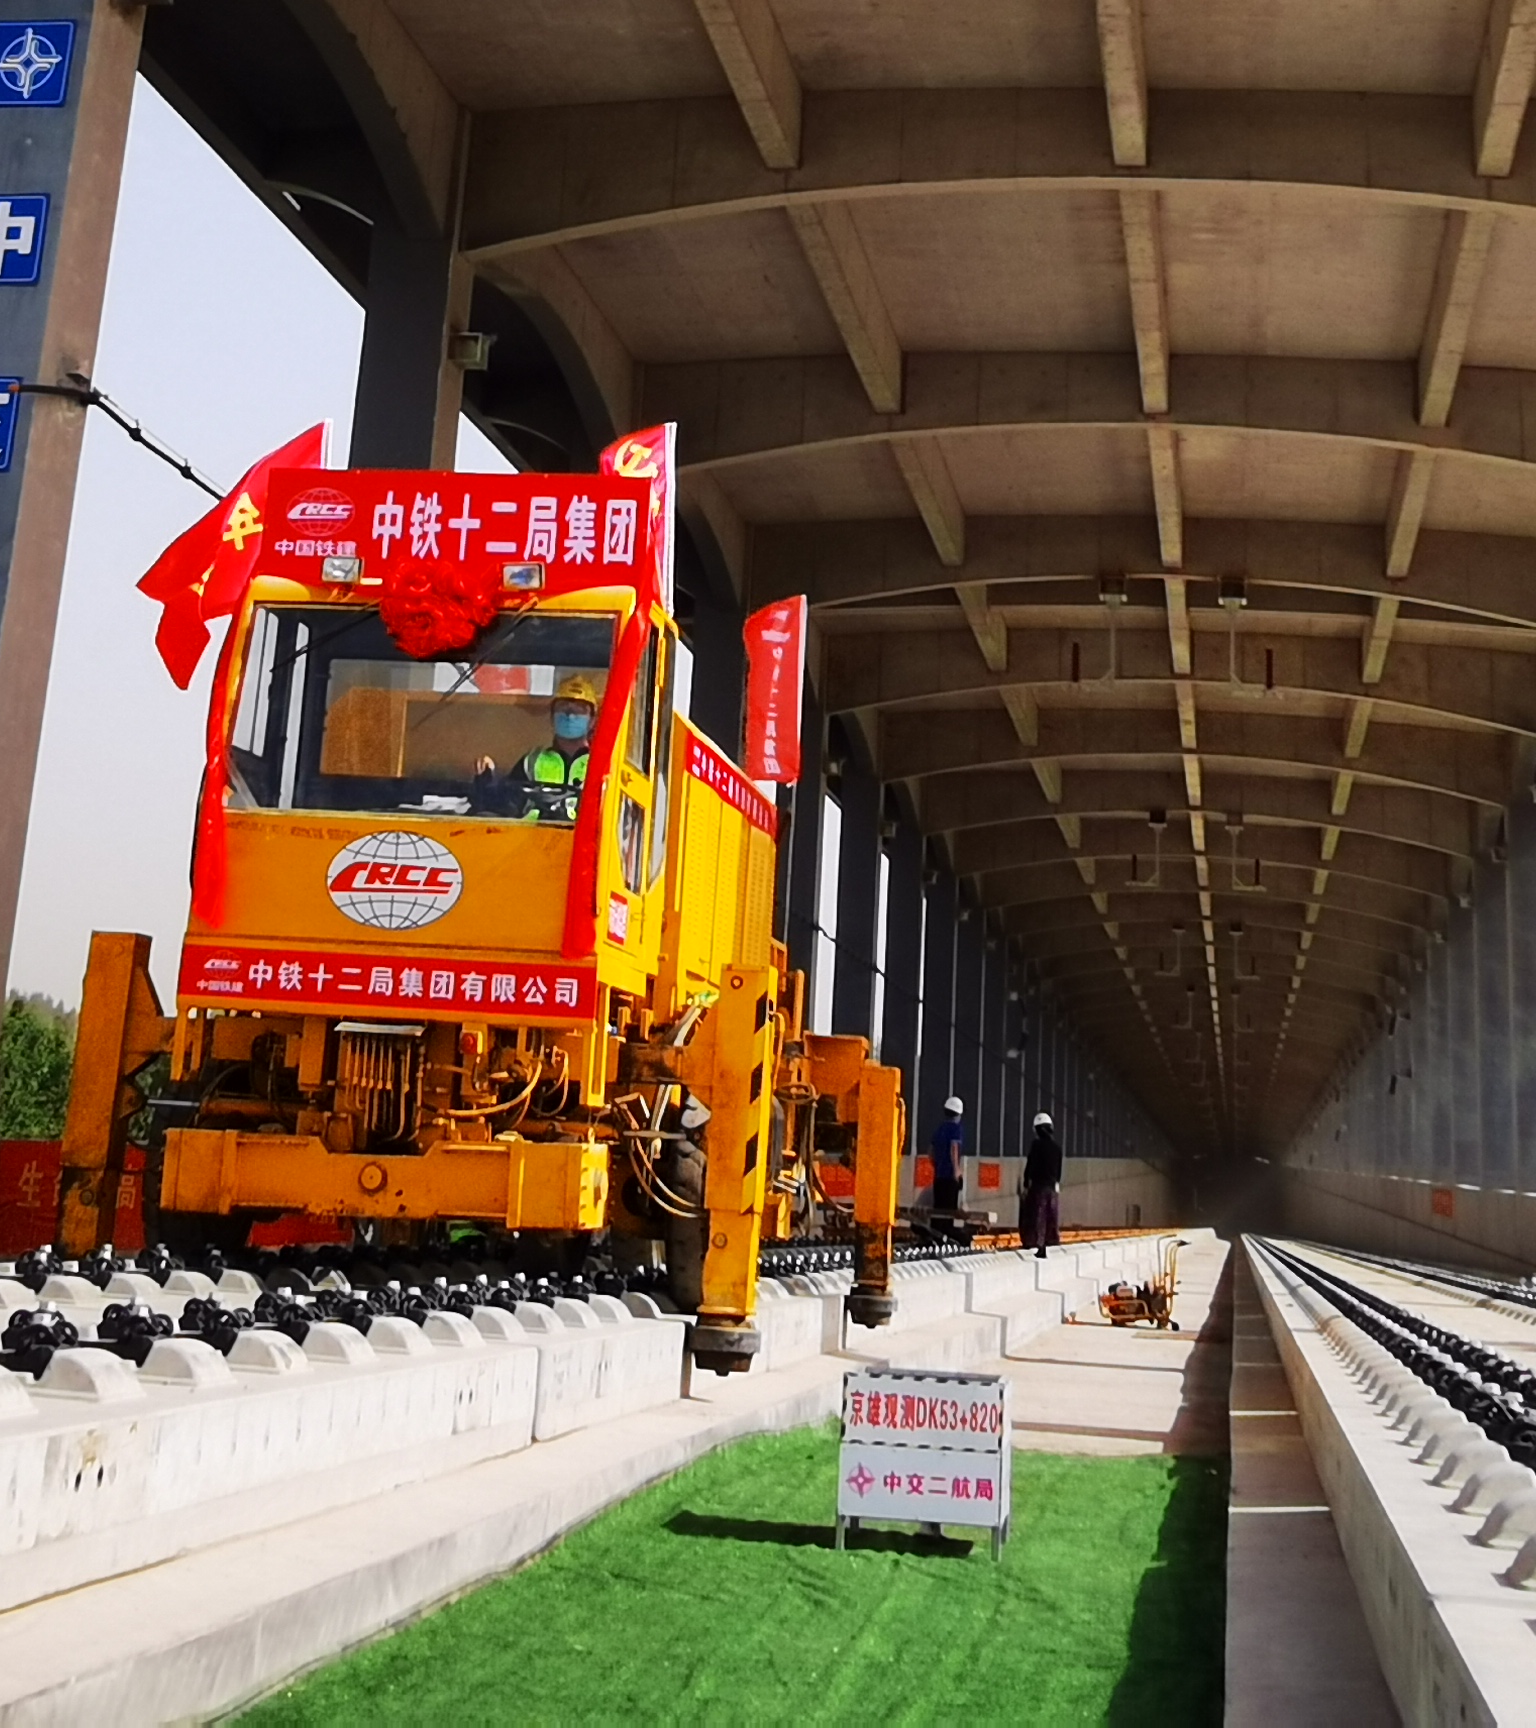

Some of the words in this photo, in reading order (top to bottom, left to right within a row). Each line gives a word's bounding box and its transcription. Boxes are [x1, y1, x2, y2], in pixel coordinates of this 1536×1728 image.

[274, 538, 357, 557] 中国铁建
[371, 490, 638, 566] 中铁十二局集团
[329, 861, 459, 894] CRCC
[248, 958, 579, 1008] 中铁十二局集团有限公司
[850, 1389, 999, 1434] 京雄观测DK53+820
[883, 1469, 994, 1502] 中交二航局
